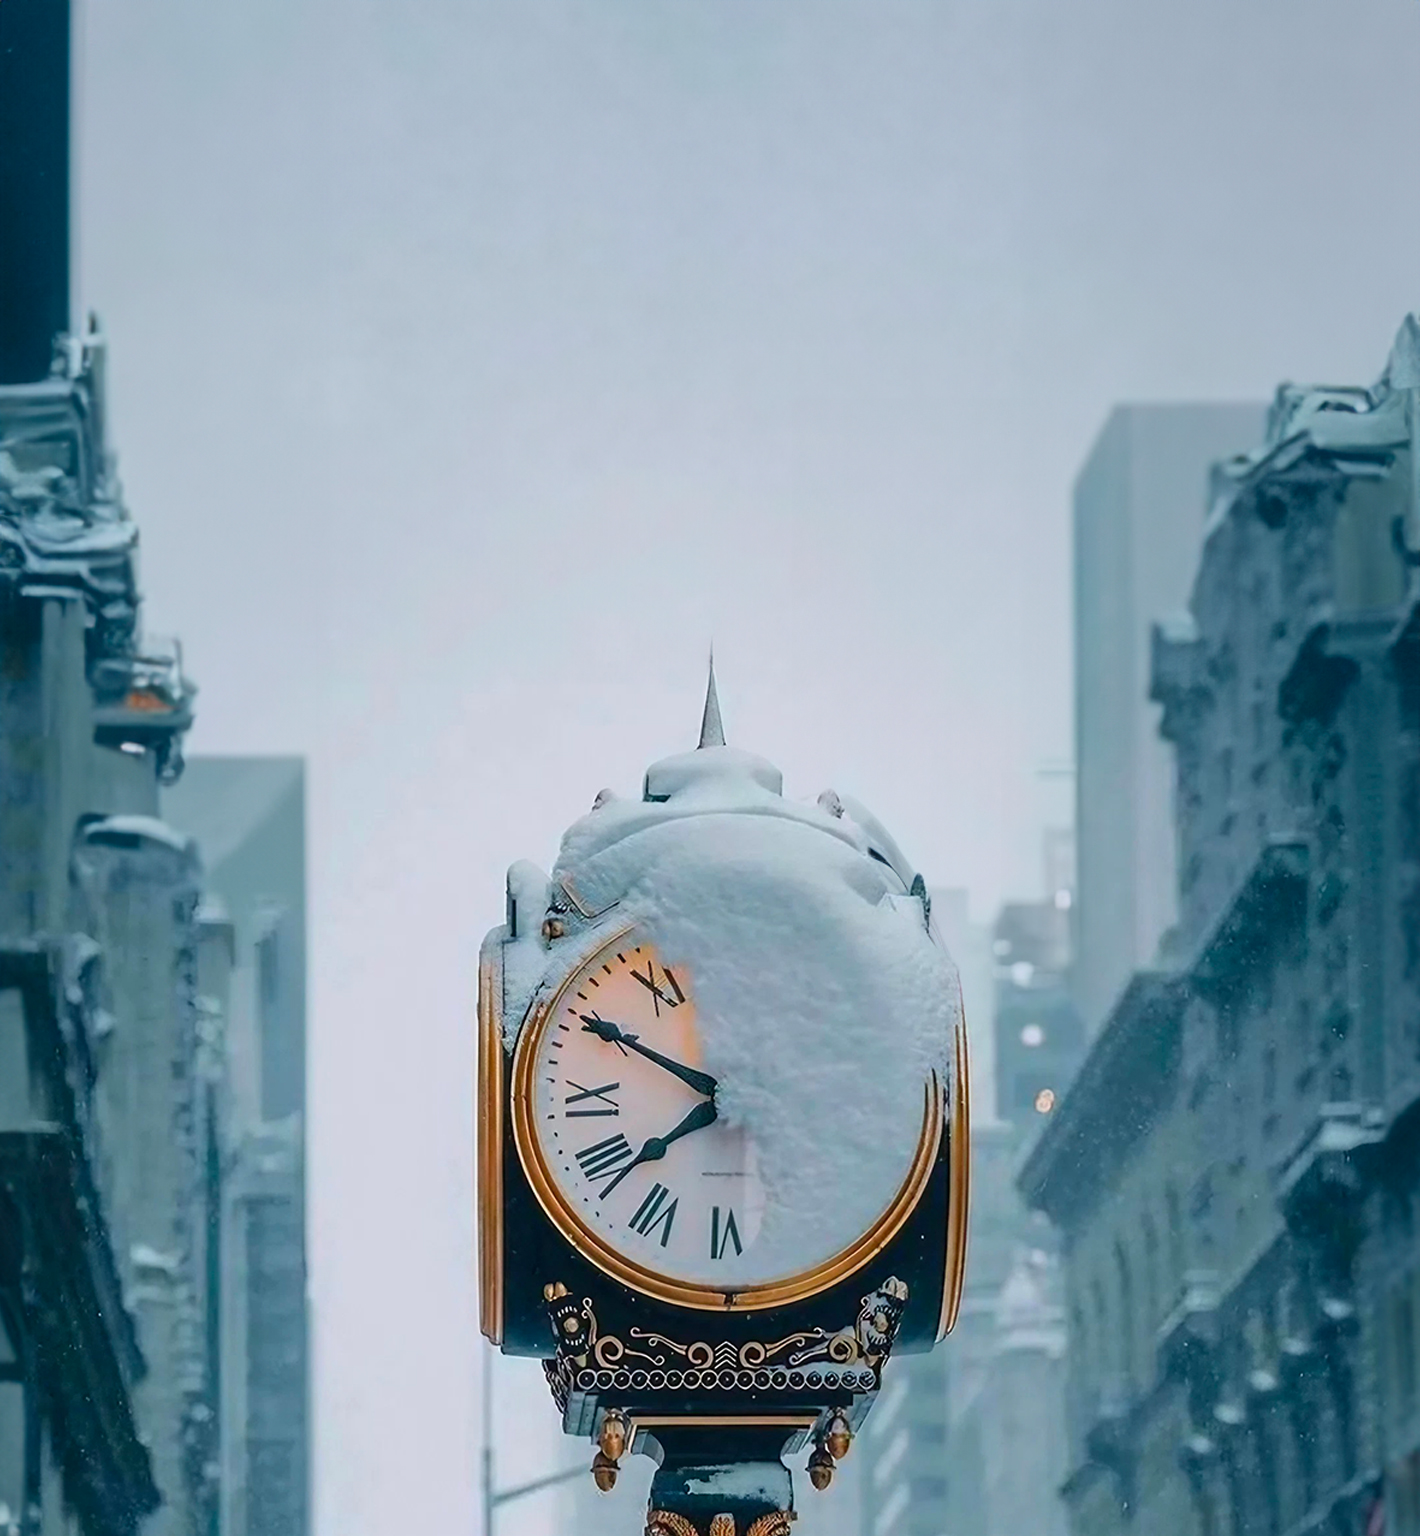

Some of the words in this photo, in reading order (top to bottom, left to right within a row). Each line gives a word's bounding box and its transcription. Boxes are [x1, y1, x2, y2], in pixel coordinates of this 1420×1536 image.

[565, 1079, 620, 1118] IX
[627, 1182, 679, 1248] VII
[710, 1206, 743, 1260] VI
